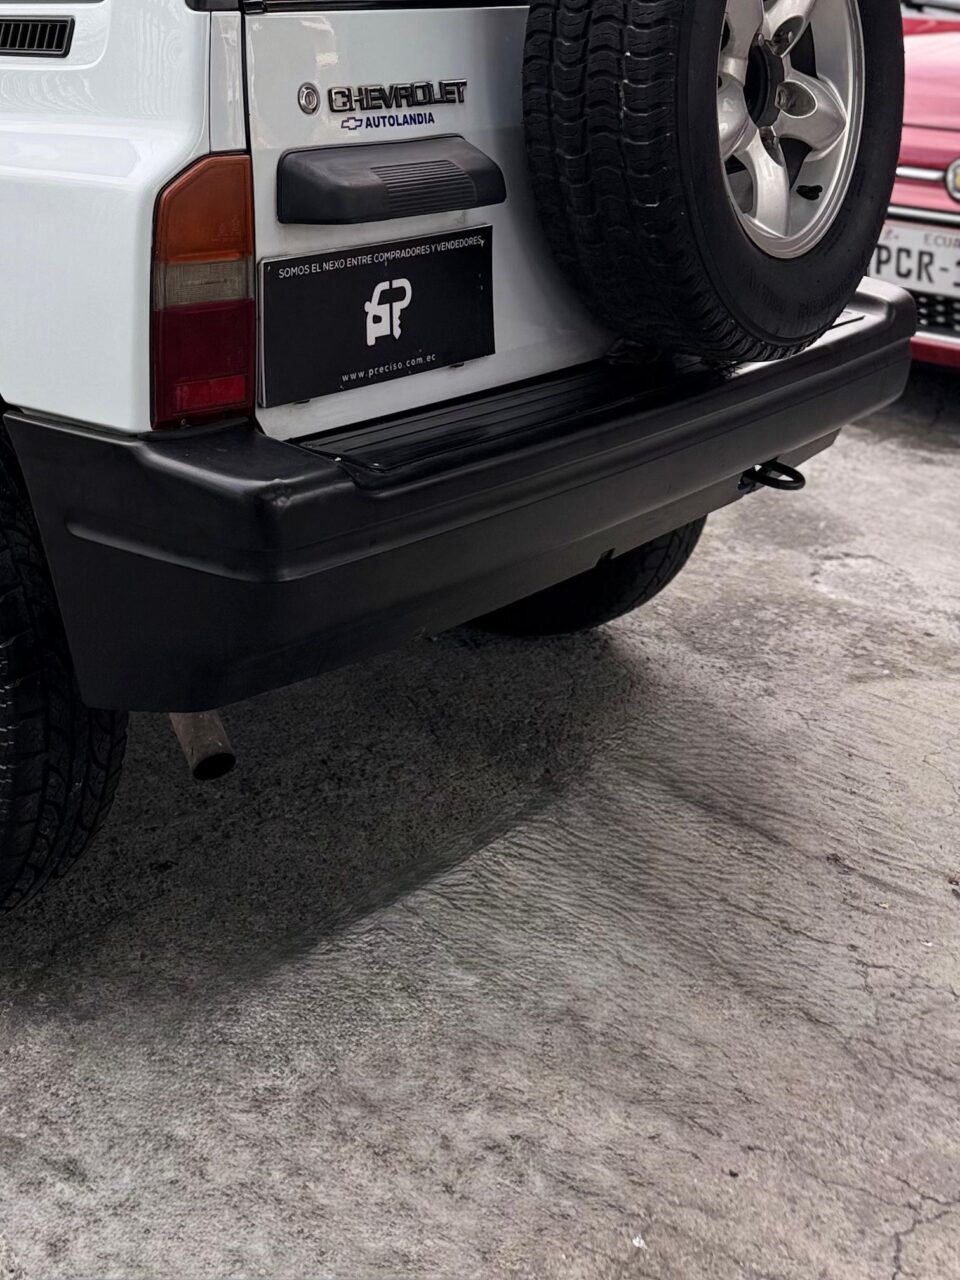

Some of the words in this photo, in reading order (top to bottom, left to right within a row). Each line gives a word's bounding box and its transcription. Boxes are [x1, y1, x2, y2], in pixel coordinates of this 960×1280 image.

[327, 79, 467, 112] CHEVROLET
[365, 112, 435, 129] AUTOLANDIA
[278, 264, 310, 278] SOMOS
[311, 263, 321, 273] EL
[322, 259, 345, 271] NEXO
[346, 254, 372, 267] ENTRE
[373, 245, 430, 263] COMPRADORES
[431, 245, 438, 253] Y
[437, 235, 482, 252] VENDEDORES
[341, 353, 436, 382] www.preciso.com.ec
